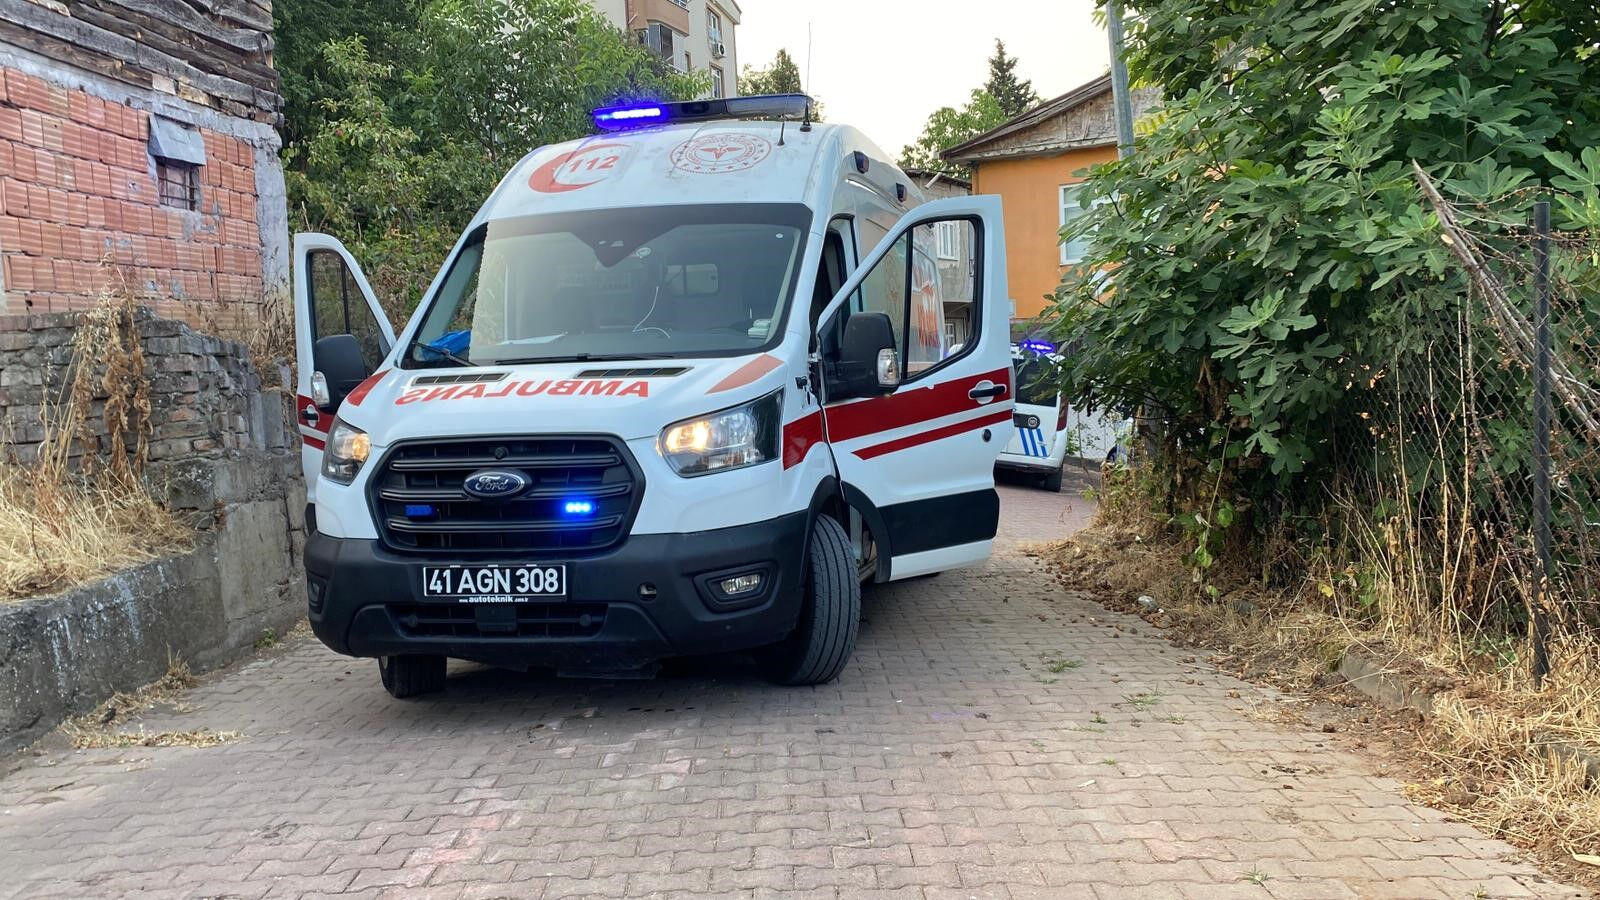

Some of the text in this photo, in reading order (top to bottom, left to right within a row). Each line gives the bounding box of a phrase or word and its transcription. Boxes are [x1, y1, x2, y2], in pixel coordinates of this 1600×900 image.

[569, 155, 620, 173] 112
[475, 475, 509, 491] Ford
[429, 568, 559, 593] 41 AGN 308
